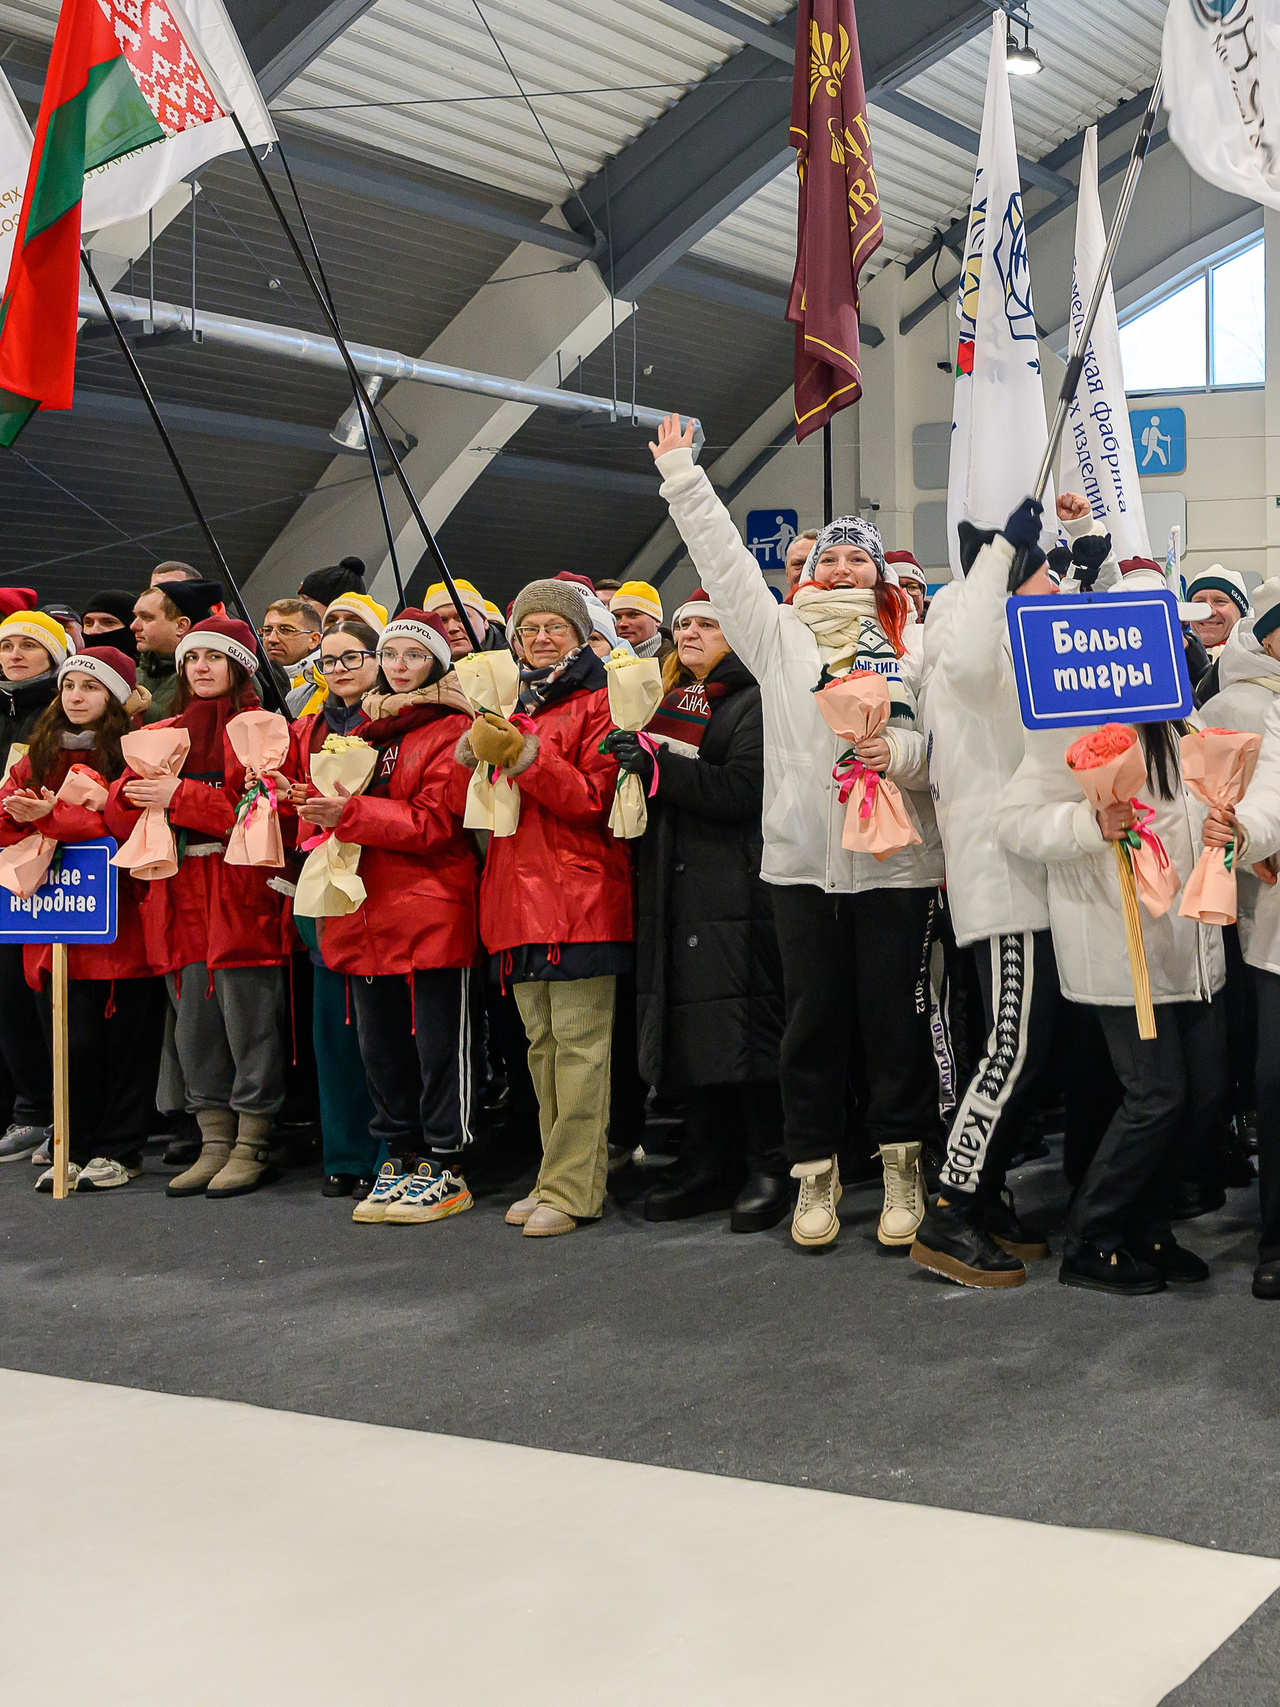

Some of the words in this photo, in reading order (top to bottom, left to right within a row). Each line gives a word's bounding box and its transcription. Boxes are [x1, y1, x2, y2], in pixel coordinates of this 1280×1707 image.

[1072, 422, 1111, 521] изделий
[1089, 401, 1127, 514] фабрика
[1051, 620, 1143, 655] Белые
[1053, 661, 1153, 698] тигры
[10, 887, 97, 919] народнае
